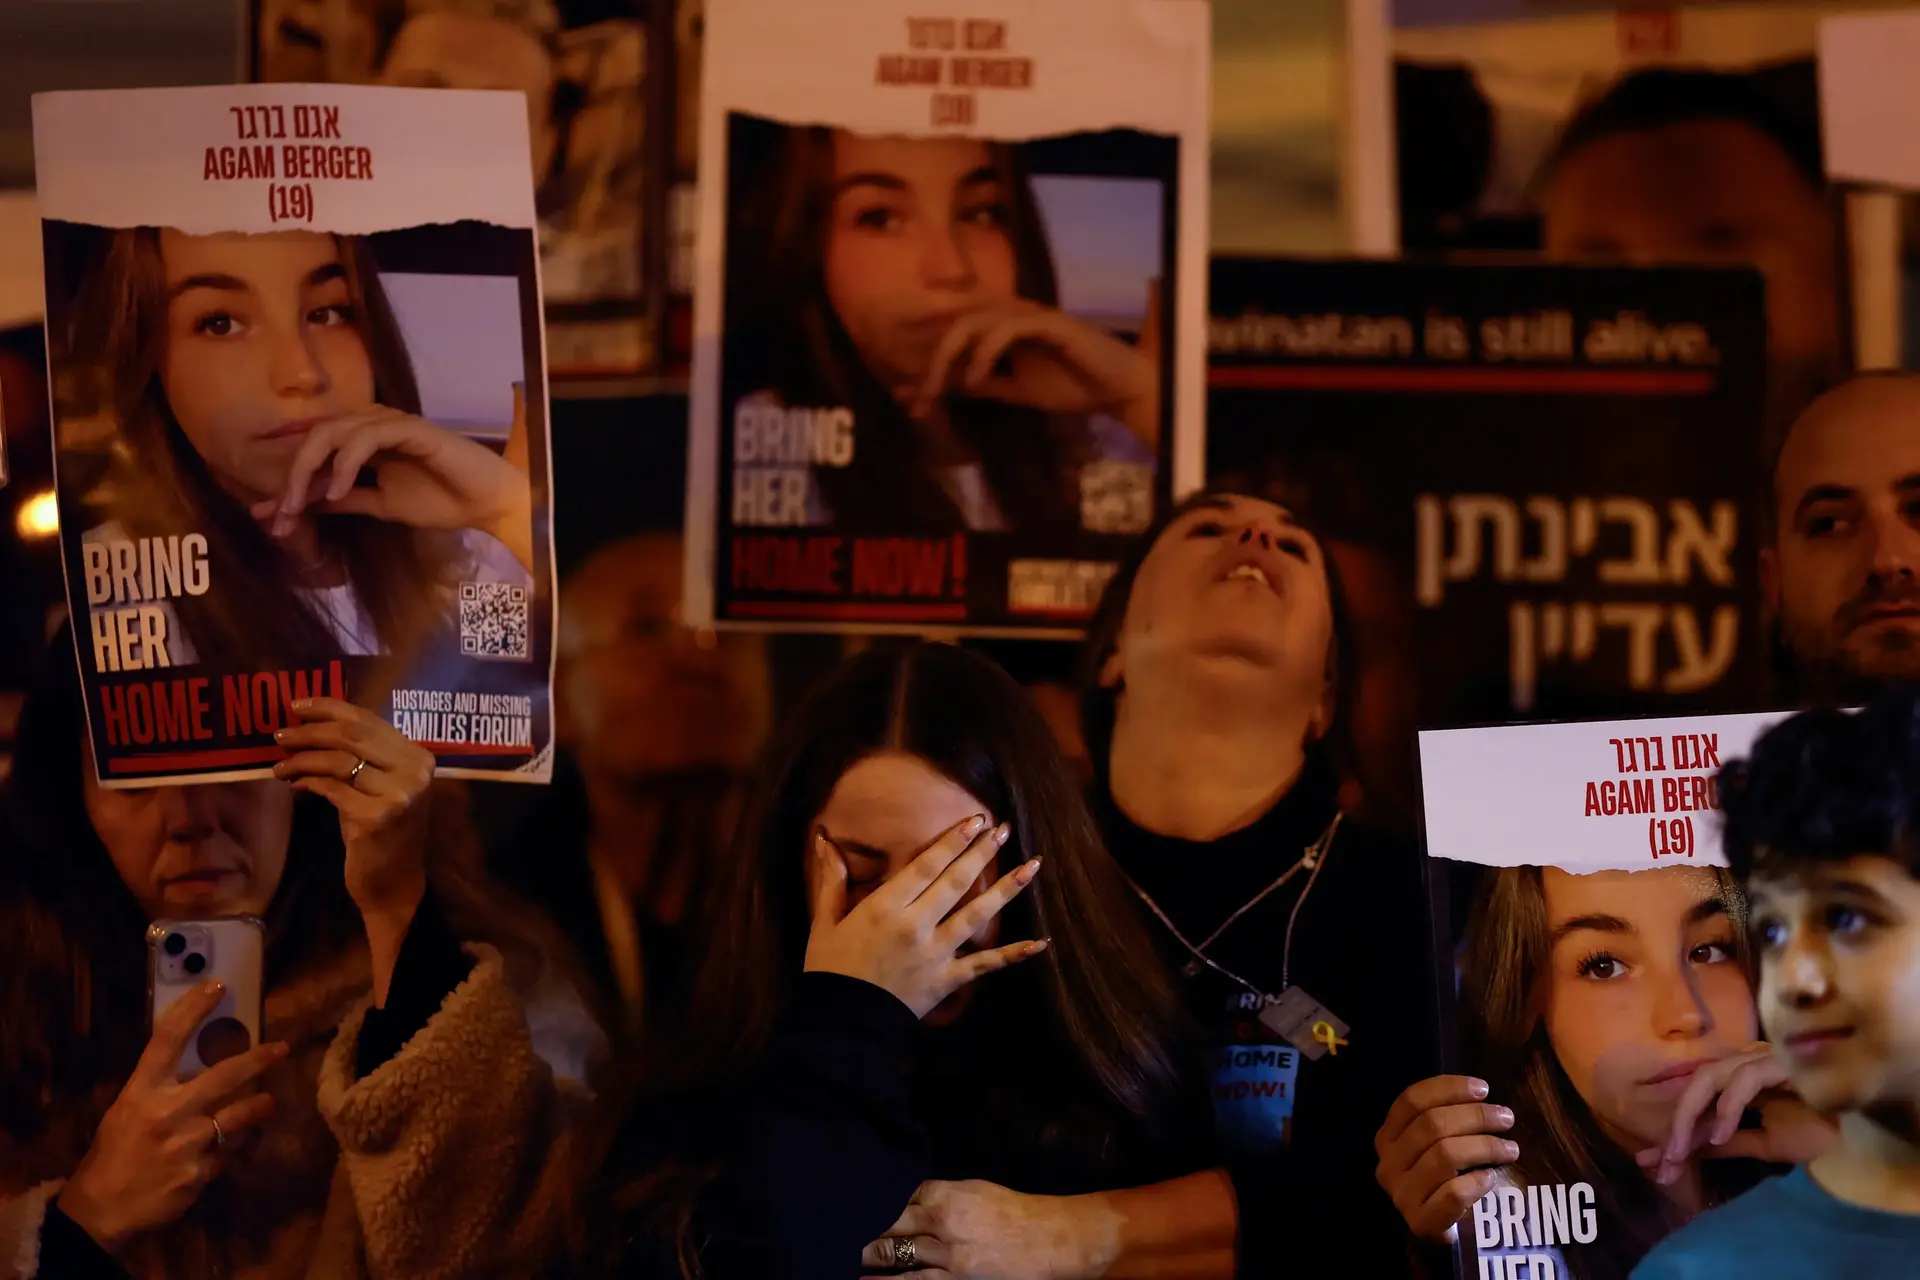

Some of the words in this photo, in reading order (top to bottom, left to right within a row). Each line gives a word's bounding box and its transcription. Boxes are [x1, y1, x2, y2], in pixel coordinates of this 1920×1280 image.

[229, 104, 287, 140] ברגר
[294, 104, 341, 139] אגם
[203, 145, 275, 181] AGAM
[282, 145, 373, 180] BERGER
[268, 182, 314, 223] (19)
[1207, 302, 1414, 355] vinatan
[733, 404, 856, 469] BRING
[731, 468, 809, 529] HER
[82, 532, 210, 606] BRING
[731, 535, 843, 593] HOME
[852, 530, 968, 598] NOW!
[1414, 491, 1740, 609] אבינתן
[90, 605, 171, 674] HER
[1508, 600, 1740, 714] עדיין
[101, 676, 214, 747] HOME
[392, 688, 452, 712] HOSTAGES
[453, 691, 478, 713] AND
[479, 694, 532, 717] MISSING
[393, 710, 467, 744] FAMILIES
[470, 714, 532, 748] FORUM
[1672, 733, 1721, 770] אגם
[1609, 736, 1666, 773] ברגר
[1584, 778, 1656, 817] AGAM
[1661, 775, 1723, 813] BERG
[1649, 816, 1694, 859] (19)
[1472, 1181, 1598, 1249] BRING
